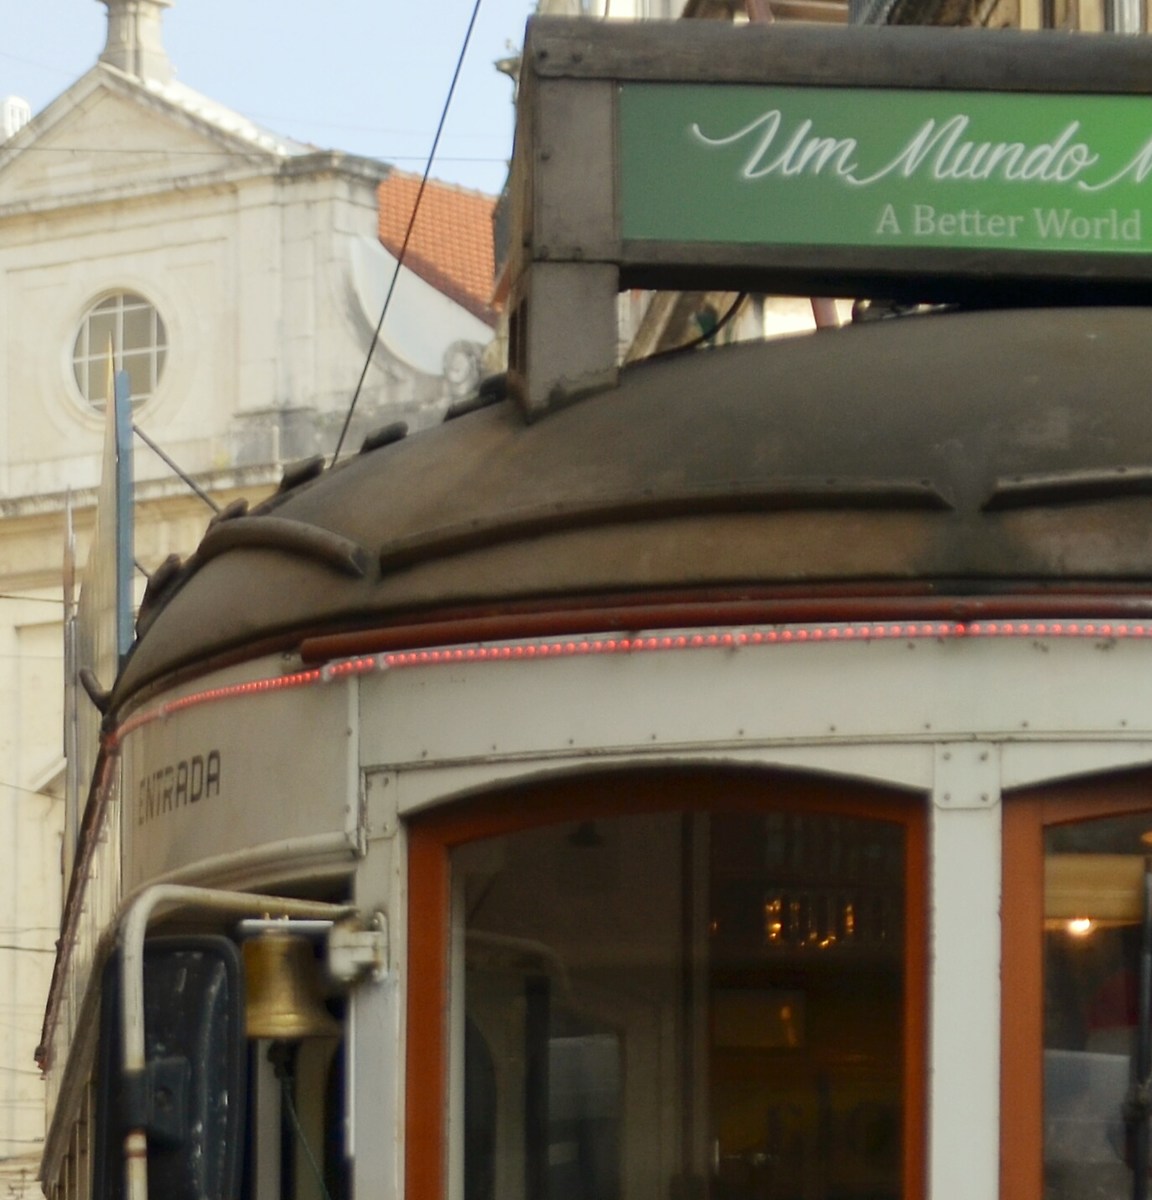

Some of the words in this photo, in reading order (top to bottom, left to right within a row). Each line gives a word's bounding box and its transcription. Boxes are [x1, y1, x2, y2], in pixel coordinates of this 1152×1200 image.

[691, 109, 858, 180] Um
[846, 113, 1101, 185] Mundo
[874, 204, 902, 236] A
[912, 205, 1025, 238] Better
[1033, 207, 1142, 242] World
[137, 749, 221, 827] ENTRADA
